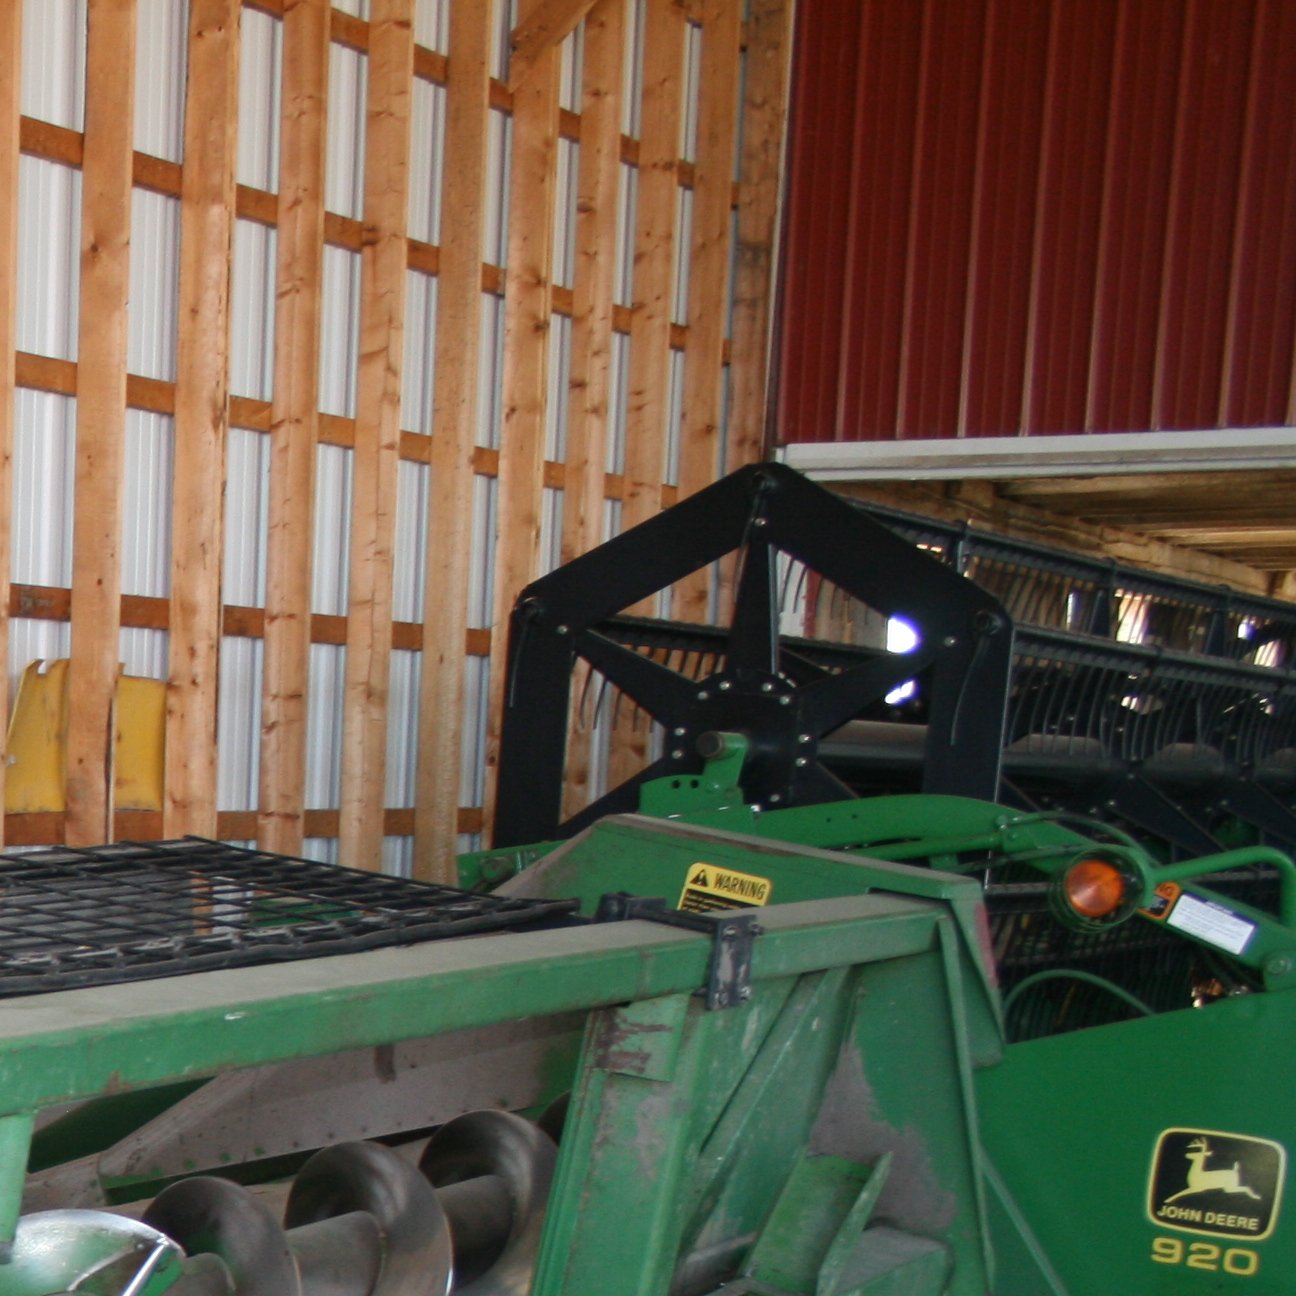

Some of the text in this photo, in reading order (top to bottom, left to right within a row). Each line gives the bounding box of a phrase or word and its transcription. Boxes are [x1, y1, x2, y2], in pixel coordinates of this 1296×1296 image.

[714, 873, 766, 899] WARNING
[1157, 1206, 1259, 1230] JOHN DEERE
[1151, 1237, 1259, 1275] 920
